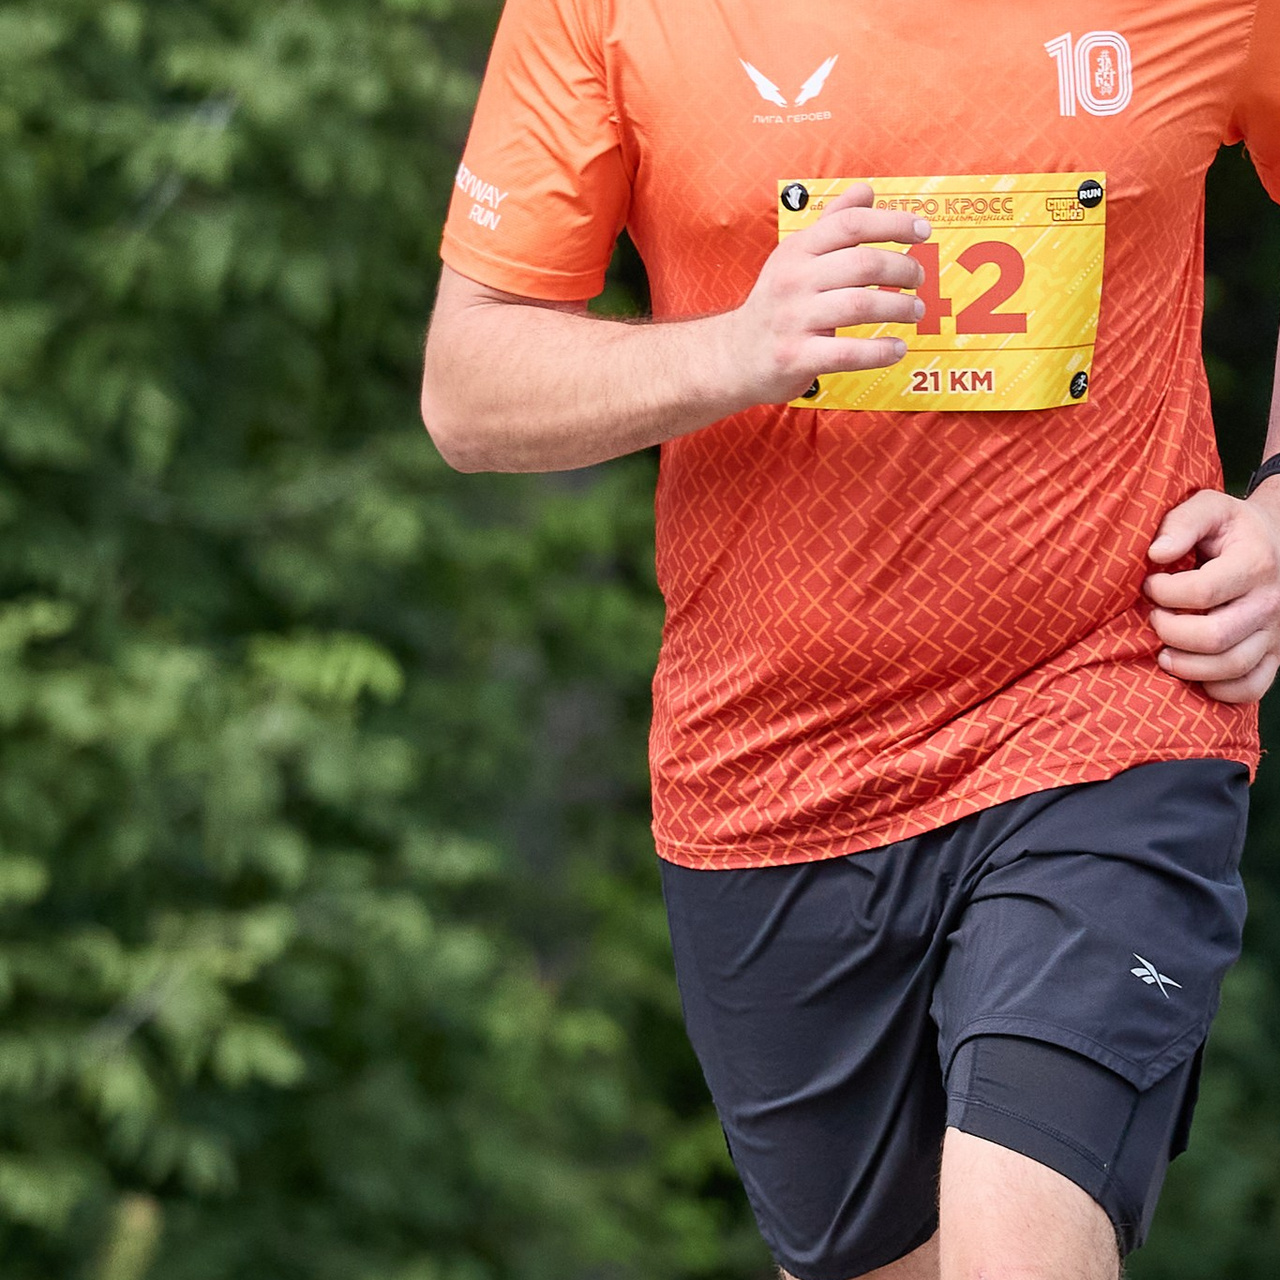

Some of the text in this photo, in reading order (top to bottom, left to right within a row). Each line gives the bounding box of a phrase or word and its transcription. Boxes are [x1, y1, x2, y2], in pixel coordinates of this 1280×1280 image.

[1043, 30, 1133, 117] 10
[752, 110, 832, 124] ЛИГА ГЕРОЕВ
[1079, 188, 1102, 200] RUN
[944, 197, 1014, 215] КРОСС
[468, 203, 502, 231] RUN
[912, 371, 940, 391] 21
